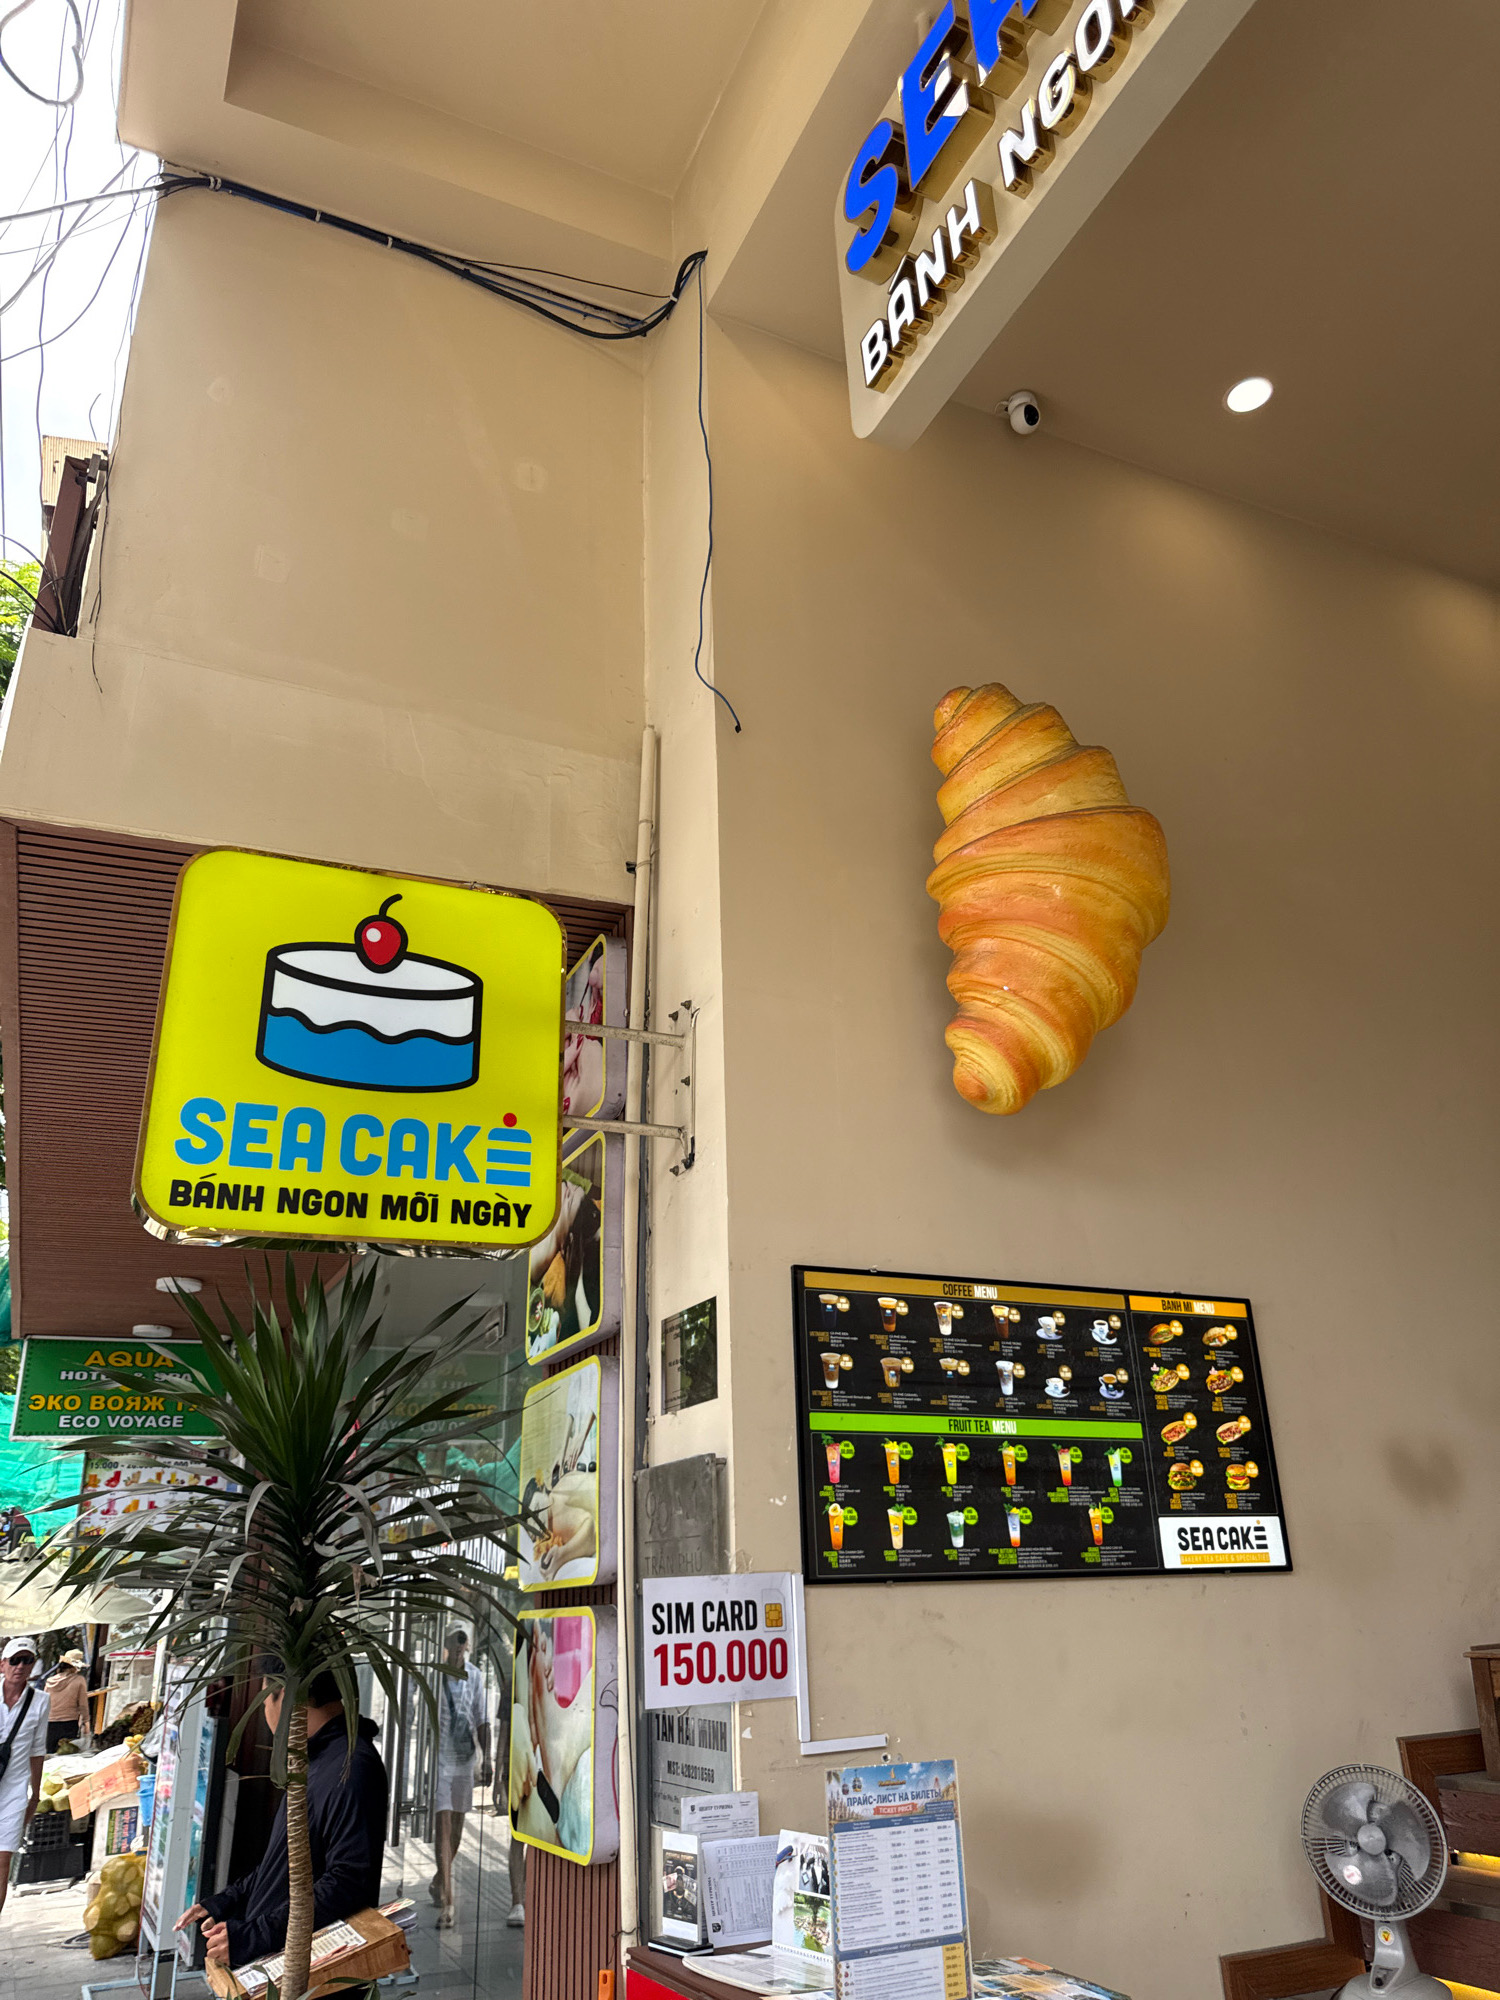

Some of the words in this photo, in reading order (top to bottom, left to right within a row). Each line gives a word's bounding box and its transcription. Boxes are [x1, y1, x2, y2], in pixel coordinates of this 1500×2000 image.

[859, 177, 982, 389] BÁNH
[997, 0, 1138, 190] NGO
[174, 1097, 326, 1173] SEA
[339, 1112, 532, 1187] CAKE
[168, 1173, 265, 1213] BÁNH
[276, 1187, 367, 1219] NGON
[451, 1192, 532, 1228] NGÀY
[942, 1283, 973, 1297] COFFEE
[973, 1286, 998, 1300] MENU
[1161, 1300, 1182, 1312] BANH
[1183, 1302, 1192, 1312] MI
[1193, 1302, 1215, 1314] MENU
[84, 1350, 174, 1368] AQUA
[28, 1394, 82, 1411] ЭКО
[89, 1394, 166, 1412] ВОЯЖ
[58, 1415, 101, 1428] ECO
[107, 1415, 184, 1428] VOYAGE
[948, 1418, 972, 1433] FRUIT
[973, 1419, 991, 1433] TEA
[992, 1420, 1017, 1434] MENU
[1177, 1526, 1215, 1551] SEA
[1216, 1520, 1269, 1551] CAKE
[651, 1601, 695, 1635] SIM
[702, 1599, 758, 1632] CARD
[653, 1637, 788, 1687] 150.000
[655, 1709, 675, 1744] TÂN
[698, 1718, 727, 1753] MINH
[846, 1792, 897, 1807] ПРАЙС-ЛИСТ
[898, 1791, 909, 1801] НА
[910, 1788, 942, 1801] БИЛЕТЫ
[879, 1806, 897, 1814] TICKET
[897, 1805, 913, 1813] PRICE
